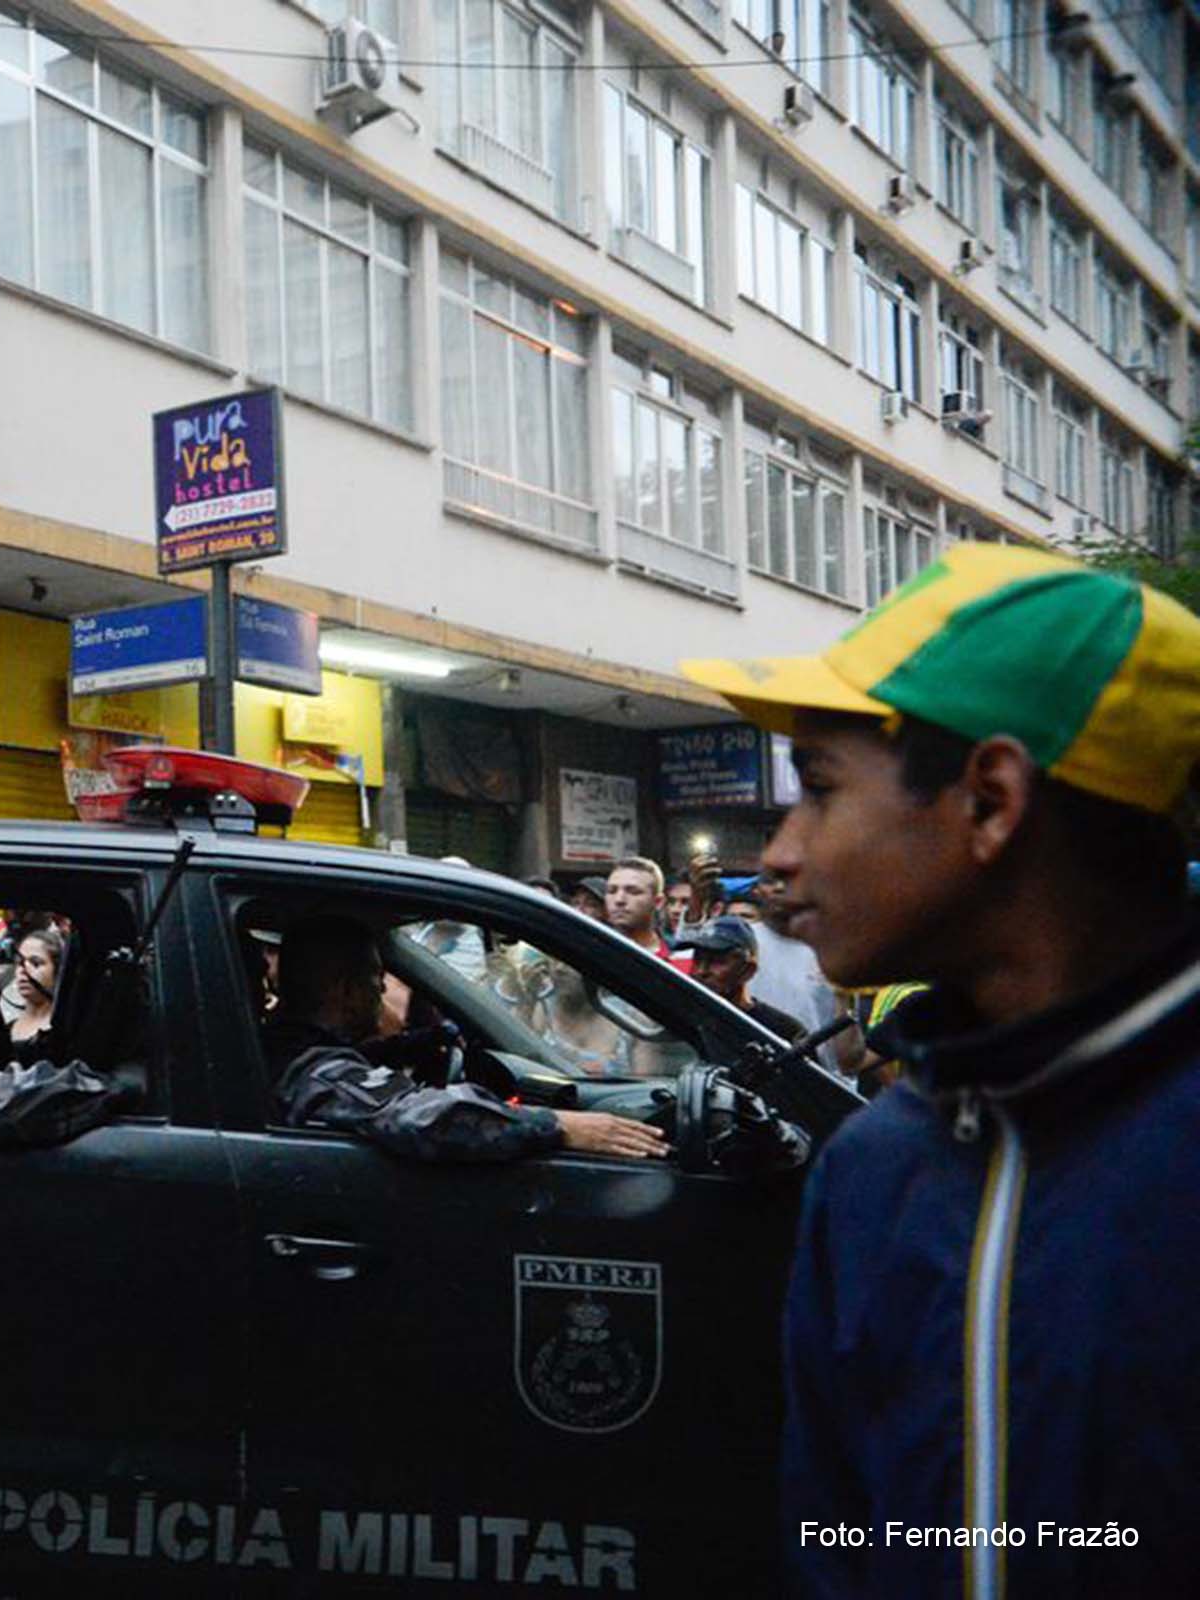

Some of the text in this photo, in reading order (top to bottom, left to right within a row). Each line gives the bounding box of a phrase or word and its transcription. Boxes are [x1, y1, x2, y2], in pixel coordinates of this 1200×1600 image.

[182, 432, 251, 480] Vida
[175, 468, 253, 504] hostel
[73, 625, 150, 648] Saint Roman
[74, 619, 96, 631] Rua
[523, 1261, 654, 1287] PMERJ
[317, 1510, 636, 1590] MILITAR
